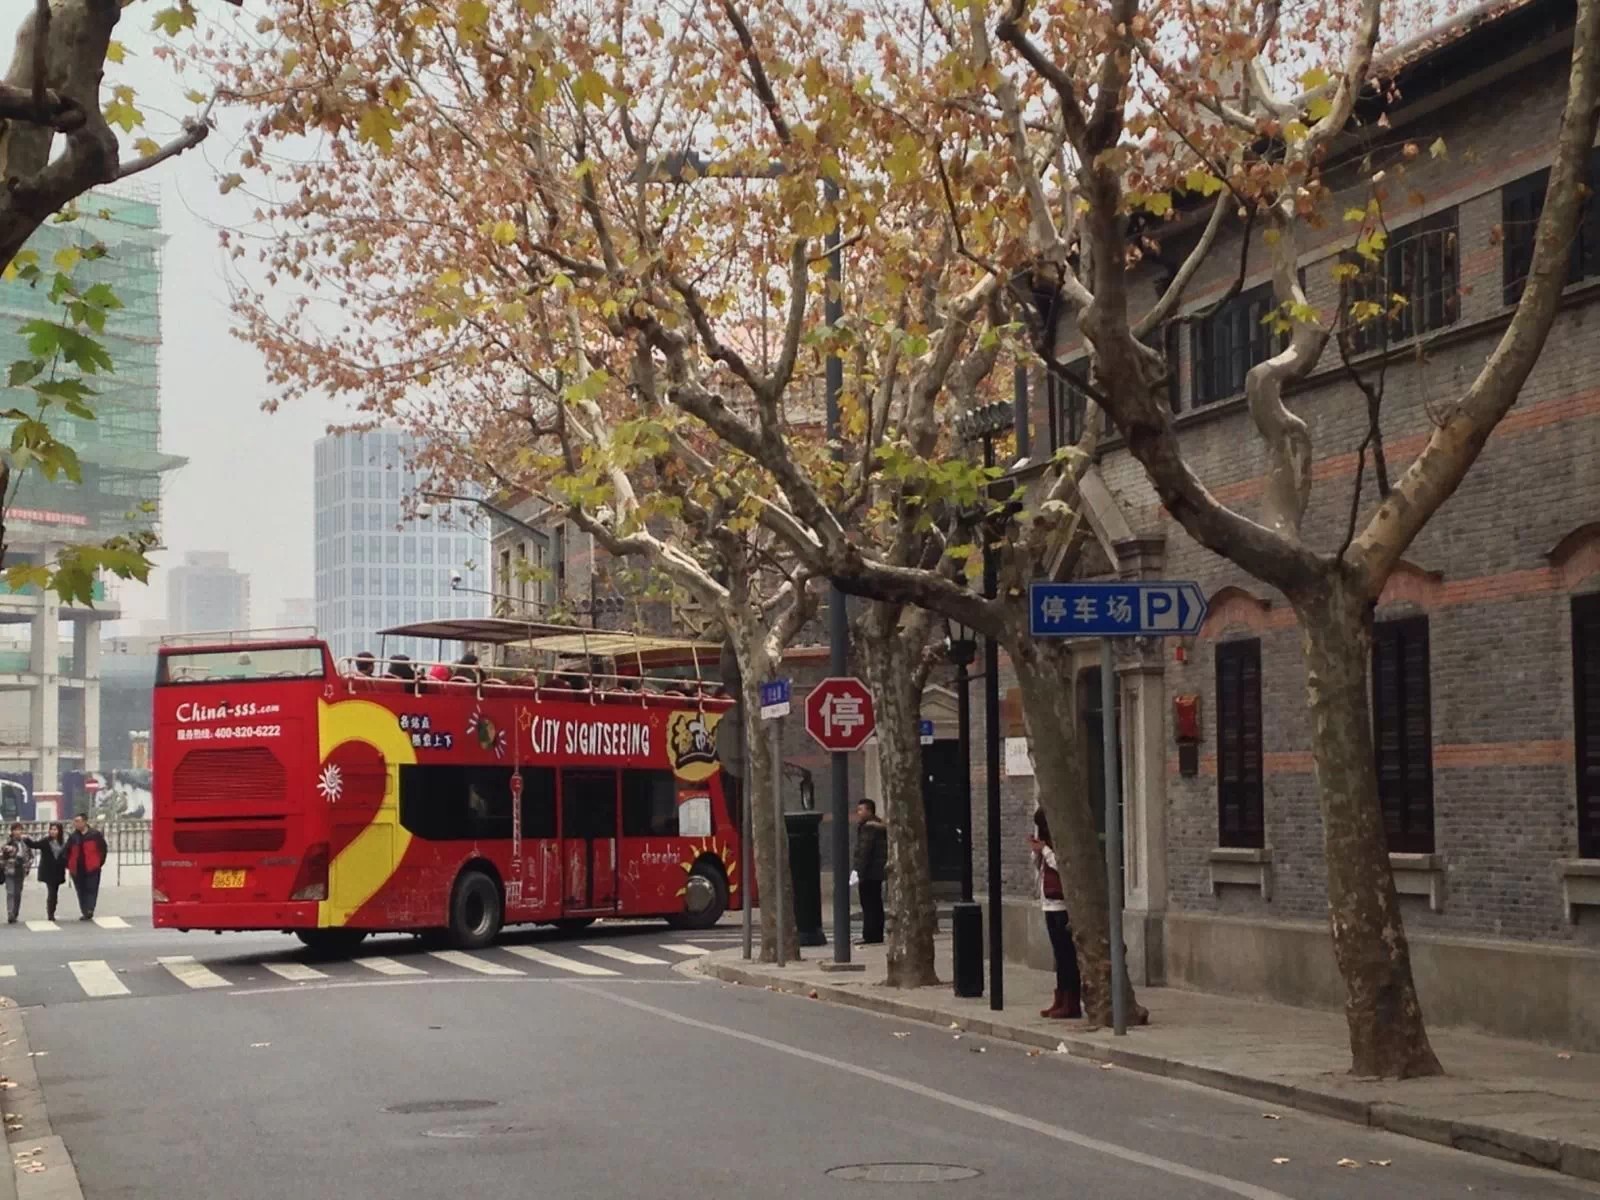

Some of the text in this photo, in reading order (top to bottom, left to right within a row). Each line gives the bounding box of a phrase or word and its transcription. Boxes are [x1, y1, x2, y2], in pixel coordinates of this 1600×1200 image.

[1040, 595, 1132, 624] 停车场
[1147, 591, 1172, 627] P
[818, 692, 865, 737] 停
[531, 715, 560, 754] CITY
[565, 720, 650, 757] SIGHTSEEING
